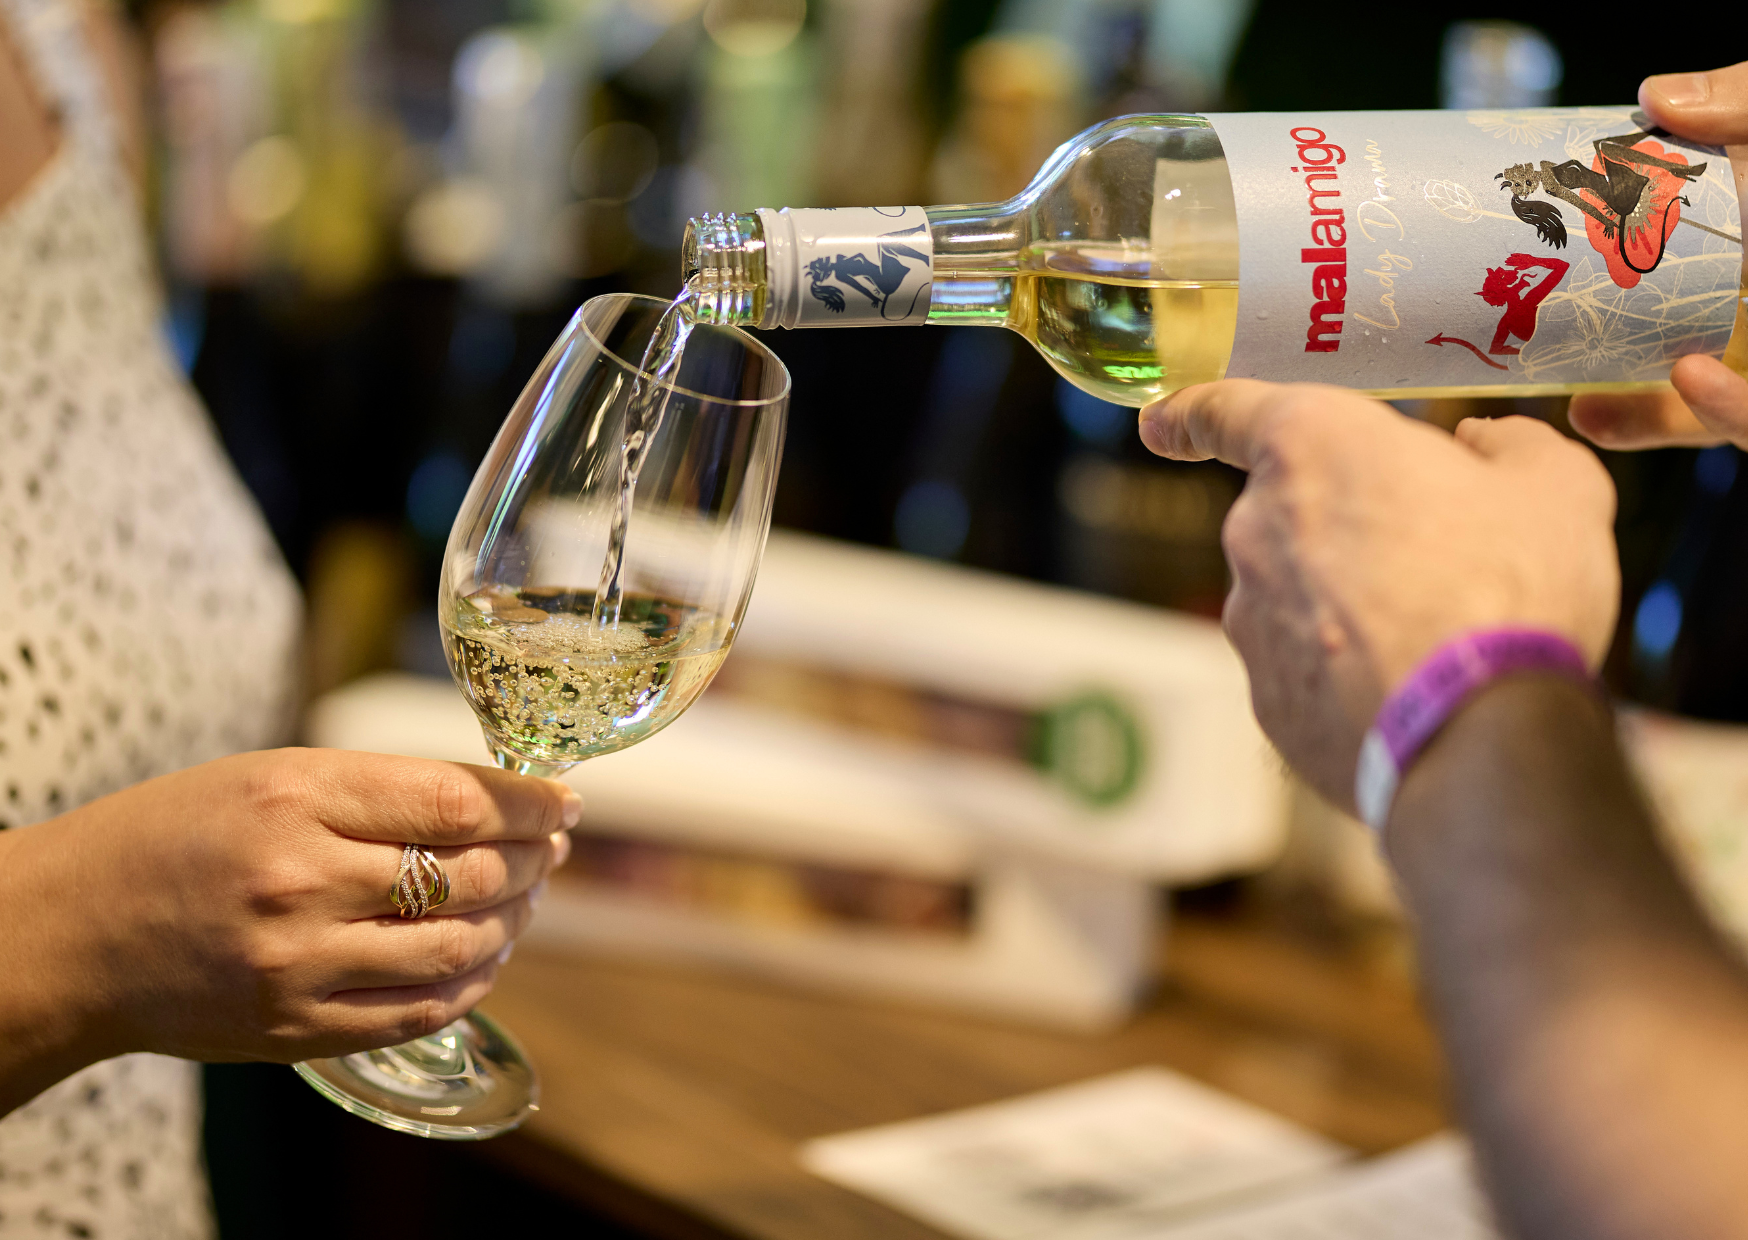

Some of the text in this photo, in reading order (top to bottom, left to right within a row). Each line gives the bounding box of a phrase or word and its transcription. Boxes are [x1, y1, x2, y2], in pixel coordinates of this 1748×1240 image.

[1290, 127, 1347, 352] malamigo
[1354, 139, 1413, 330] Lady Drama
